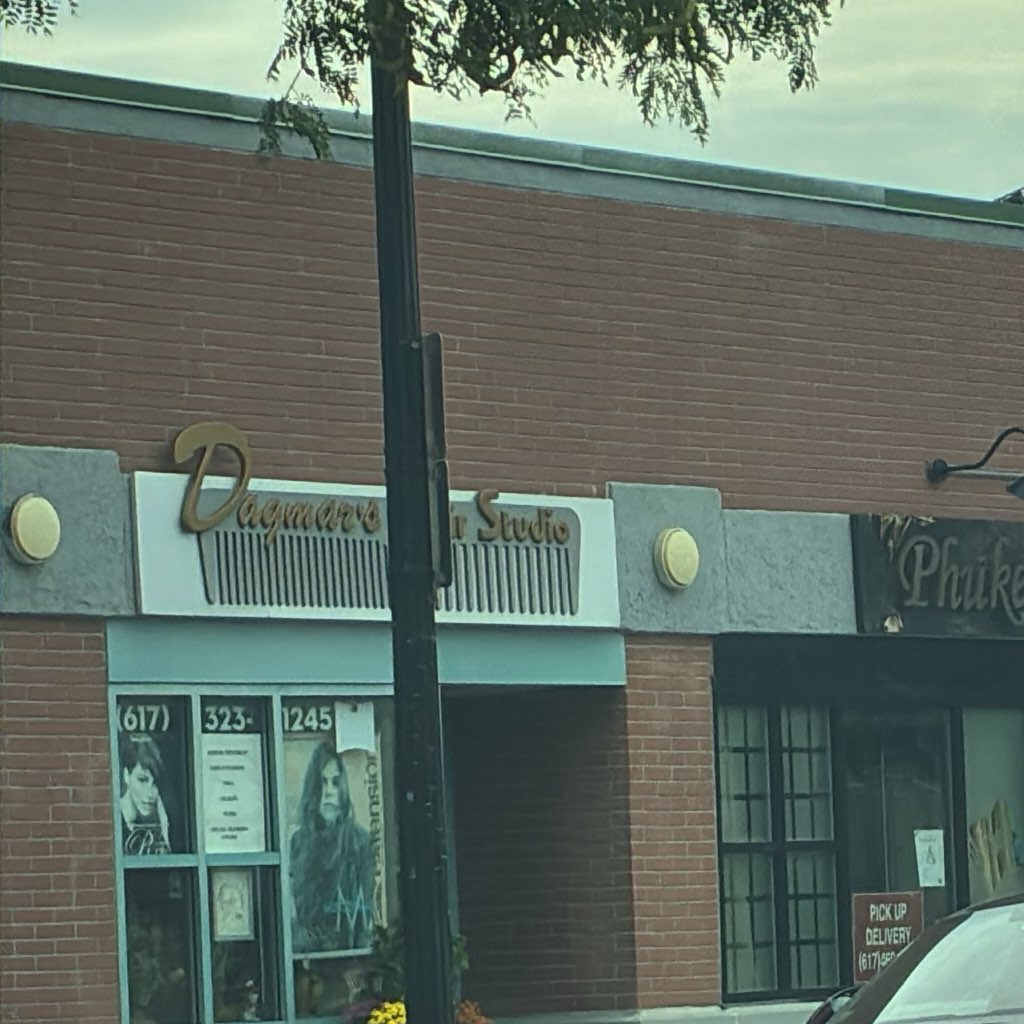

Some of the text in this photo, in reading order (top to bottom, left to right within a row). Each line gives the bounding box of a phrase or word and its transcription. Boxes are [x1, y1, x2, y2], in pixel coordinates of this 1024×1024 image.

[174, 421, 380, 546] Dagmar's
[476, 488, 569, 544] Studio
[118, 704, 333, 732] (617) 323- 1245
[870, 902, 907, 921] PICK UP
[866, 926, 912, 945] DELIVERY
